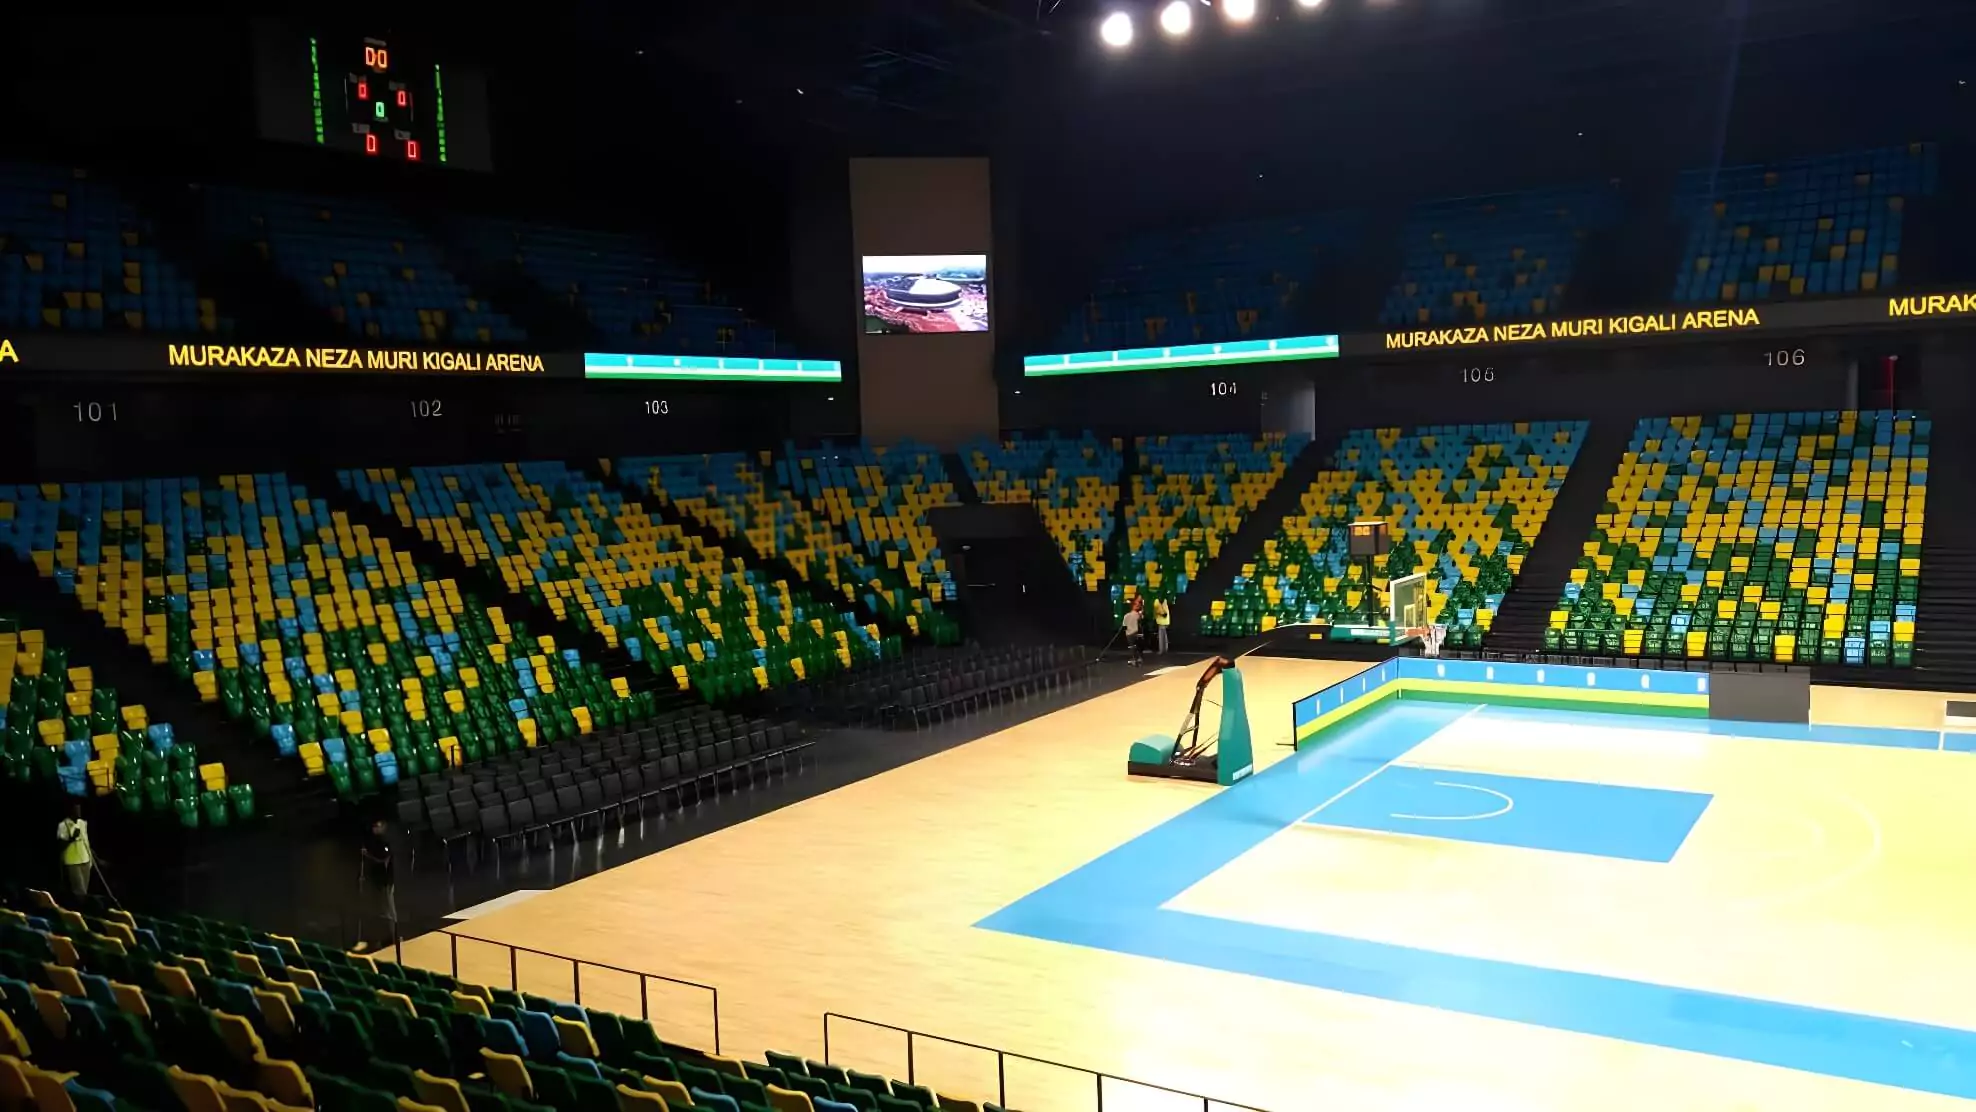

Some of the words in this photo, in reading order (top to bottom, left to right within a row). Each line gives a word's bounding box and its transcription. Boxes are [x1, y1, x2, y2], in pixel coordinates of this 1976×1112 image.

[1386, 328, 1489, 349] MURAKAZA
[1492, 322, 1548, 342] NEZA
[1550, 318, 1604, 338] MURI
[1608, 313, 1676, 335] KIGALI
[1681, 308, 1761, 331] ARENA
[168, 344, 302, 368] MURAKAZA
[305, 347, 364, 370] NEZA
[367, 350, 418, 371] MURI
[422, 350, 481, 372] KIGALI
[484, 353, 545, 373] ARENA
[1764, 349, 1806, 367] 106
[73, 402, 118, 421] 101
[410, 400, 443, 418] 102
[645, 400, 670, 416] 103
